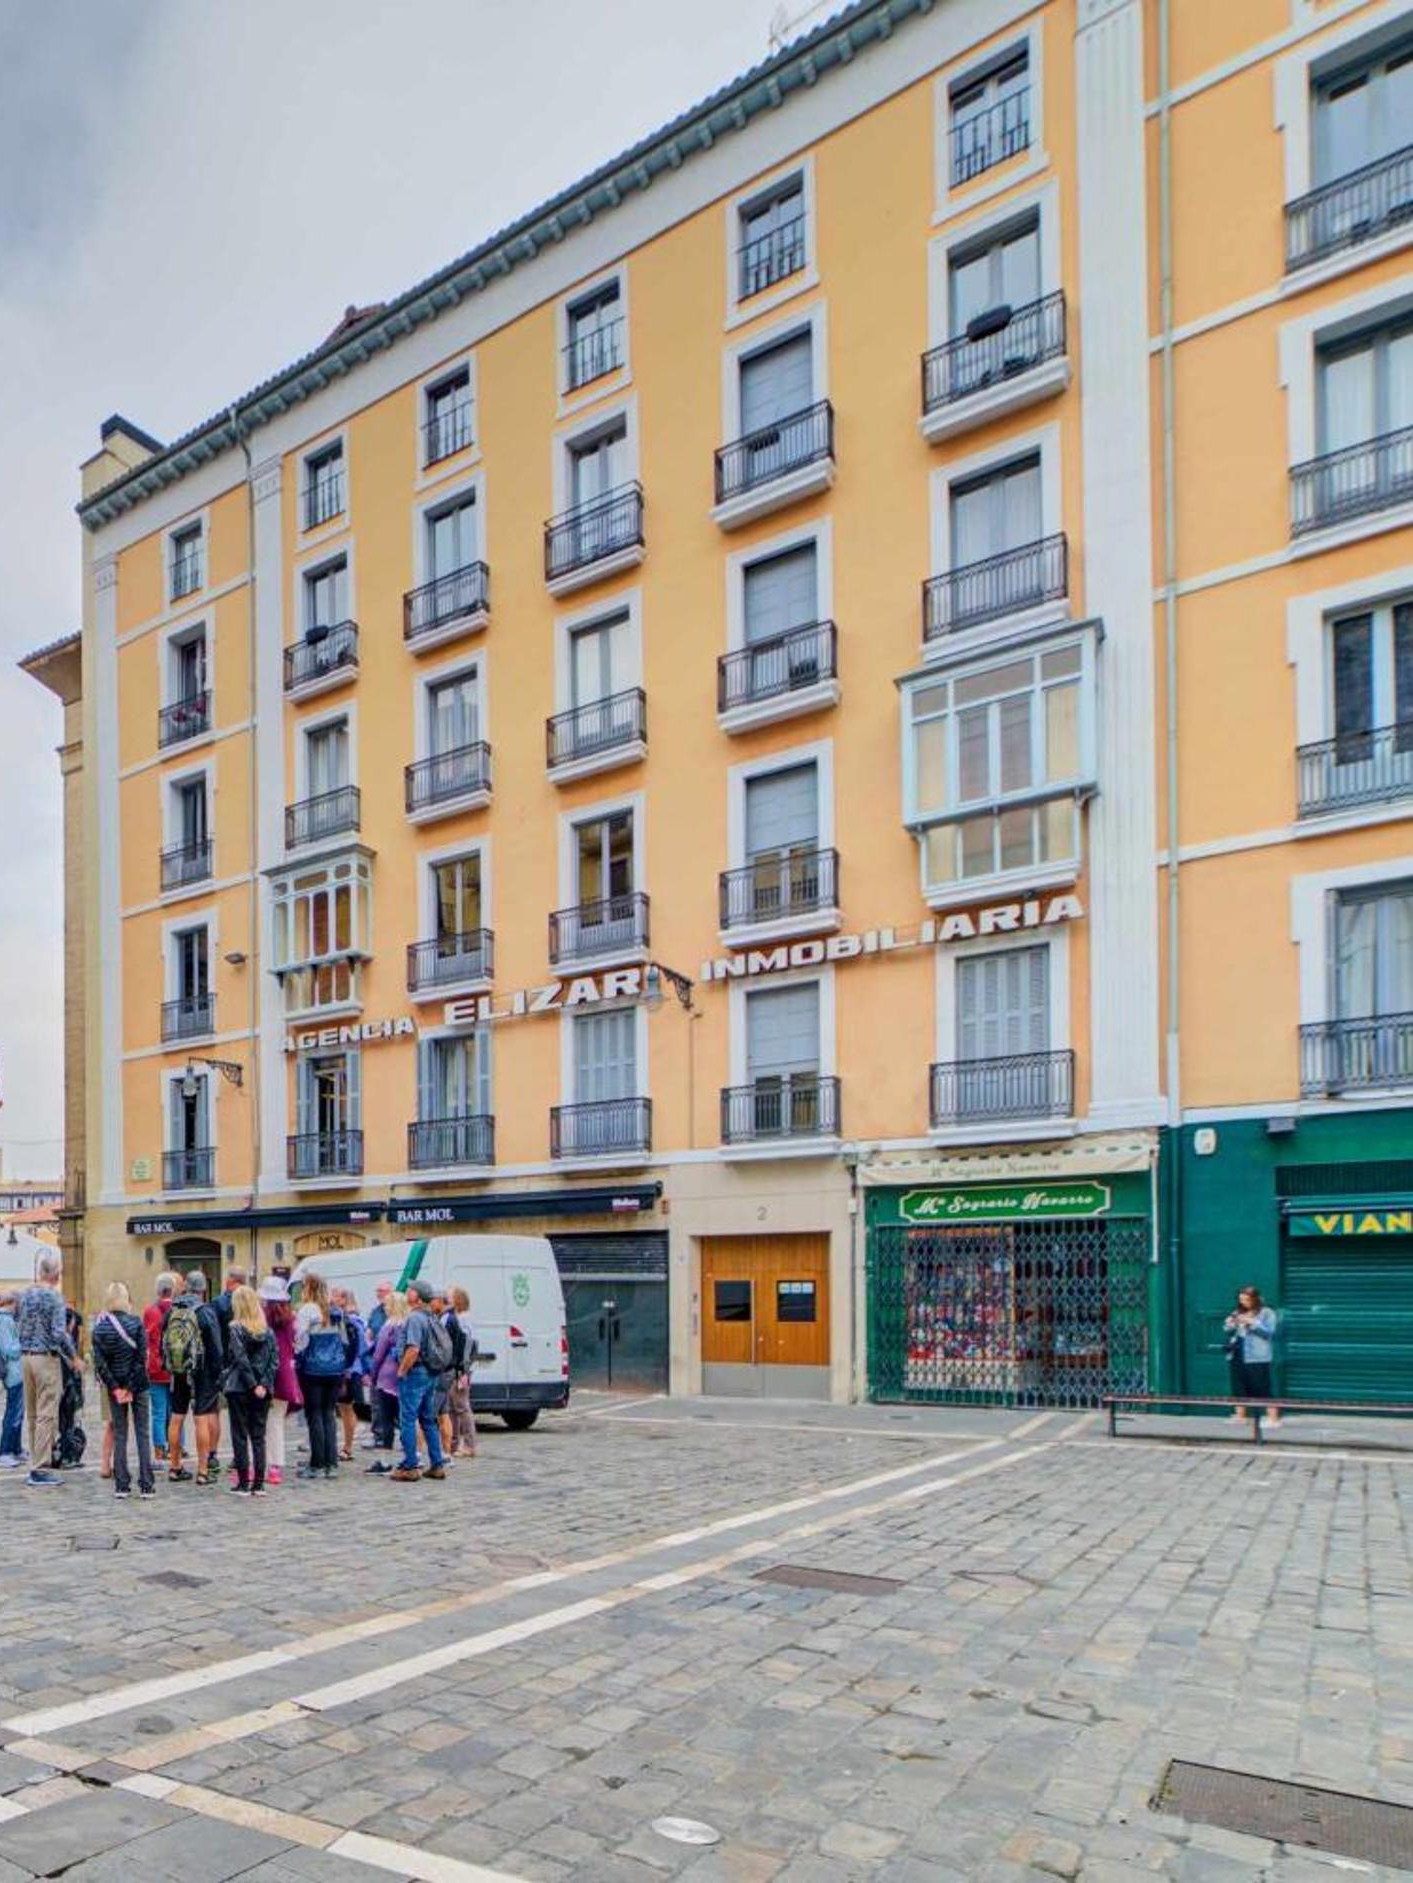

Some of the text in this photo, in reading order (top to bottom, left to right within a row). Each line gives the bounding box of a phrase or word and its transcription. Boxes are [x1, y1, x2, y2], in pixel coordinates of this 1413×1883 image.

[280, 1015, 416, 1052] AGENCIA
[700, 893, 1086, 982] INMOBILIARIA
[1020, 1191, 1093, 1210] Navarro
[396, 1207, 455, 1223] BAR MOL
[756, 1205, 768, 1221] 2
[1313, 1211, 1413, 1235] VIAN
[318, 1232, 344, 1251] MOL
